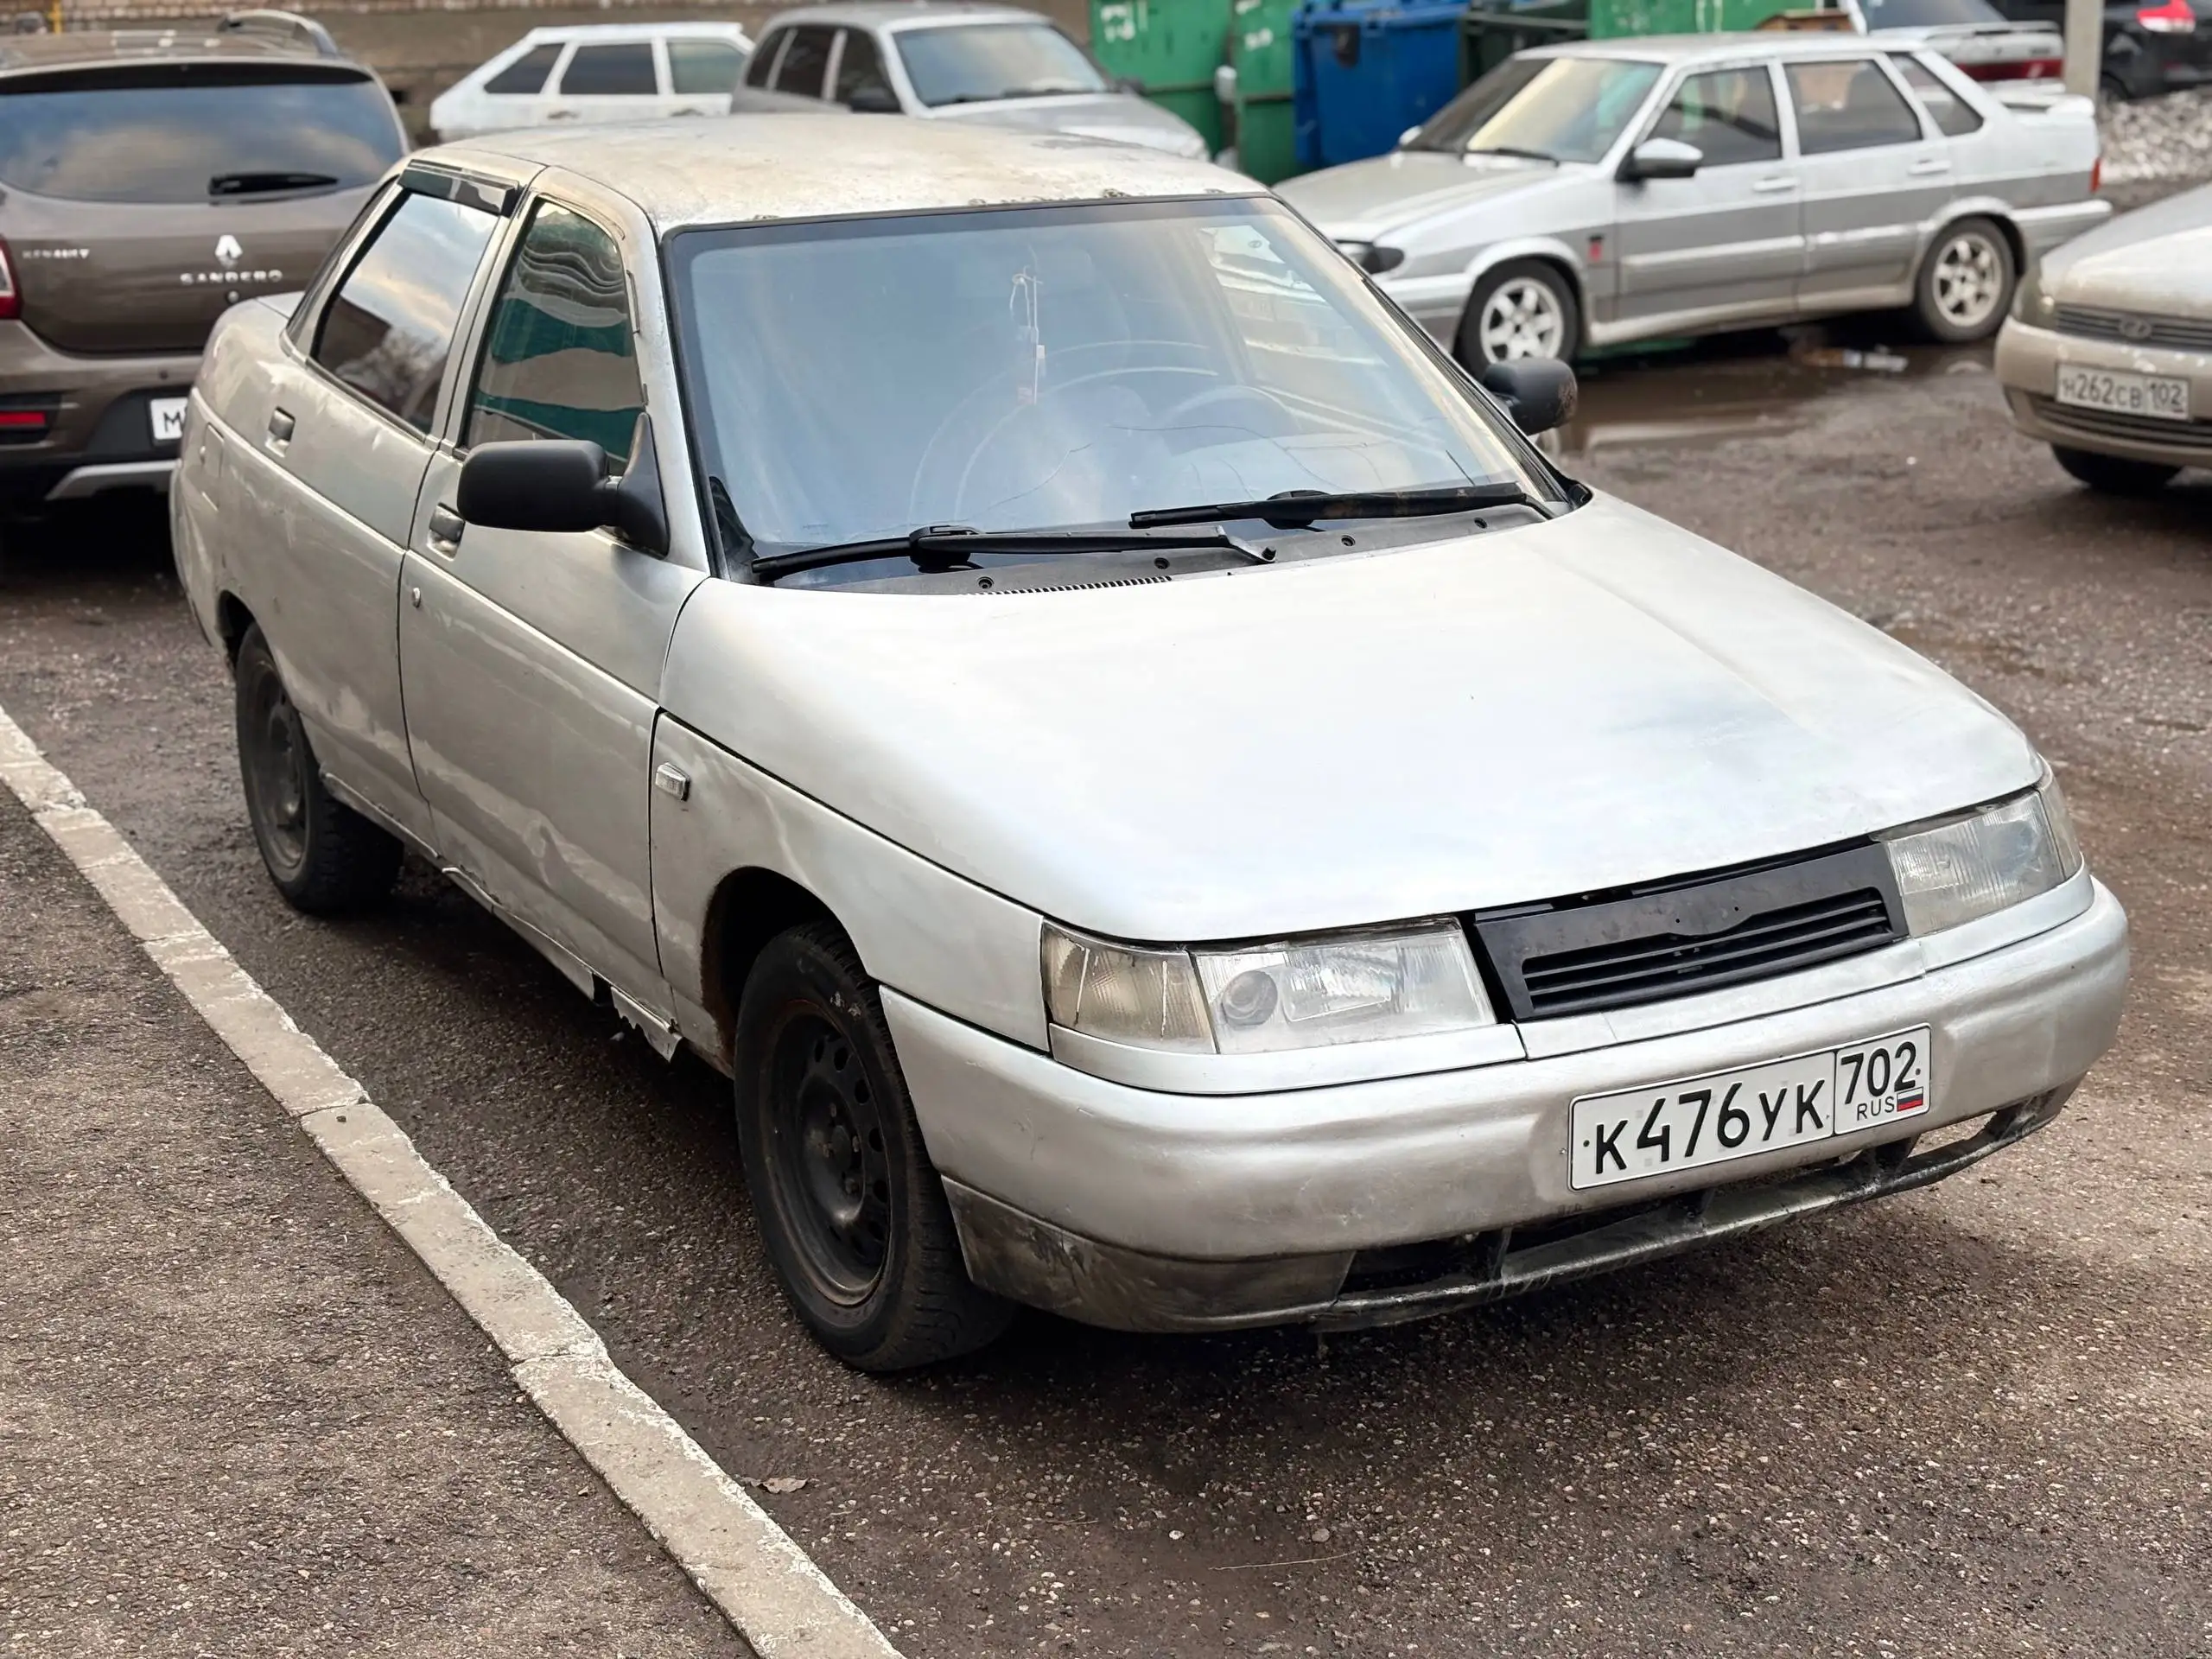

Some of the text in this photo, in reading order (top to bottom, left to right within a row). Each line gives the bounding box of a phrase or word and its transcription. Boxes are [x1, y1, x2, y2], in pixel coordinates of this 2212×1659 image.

[180, 269, 283, 286] SANDERO
[1840, 1041, 1916, 1105] 702
[1856, 1096, 1895, 1121] RUS
